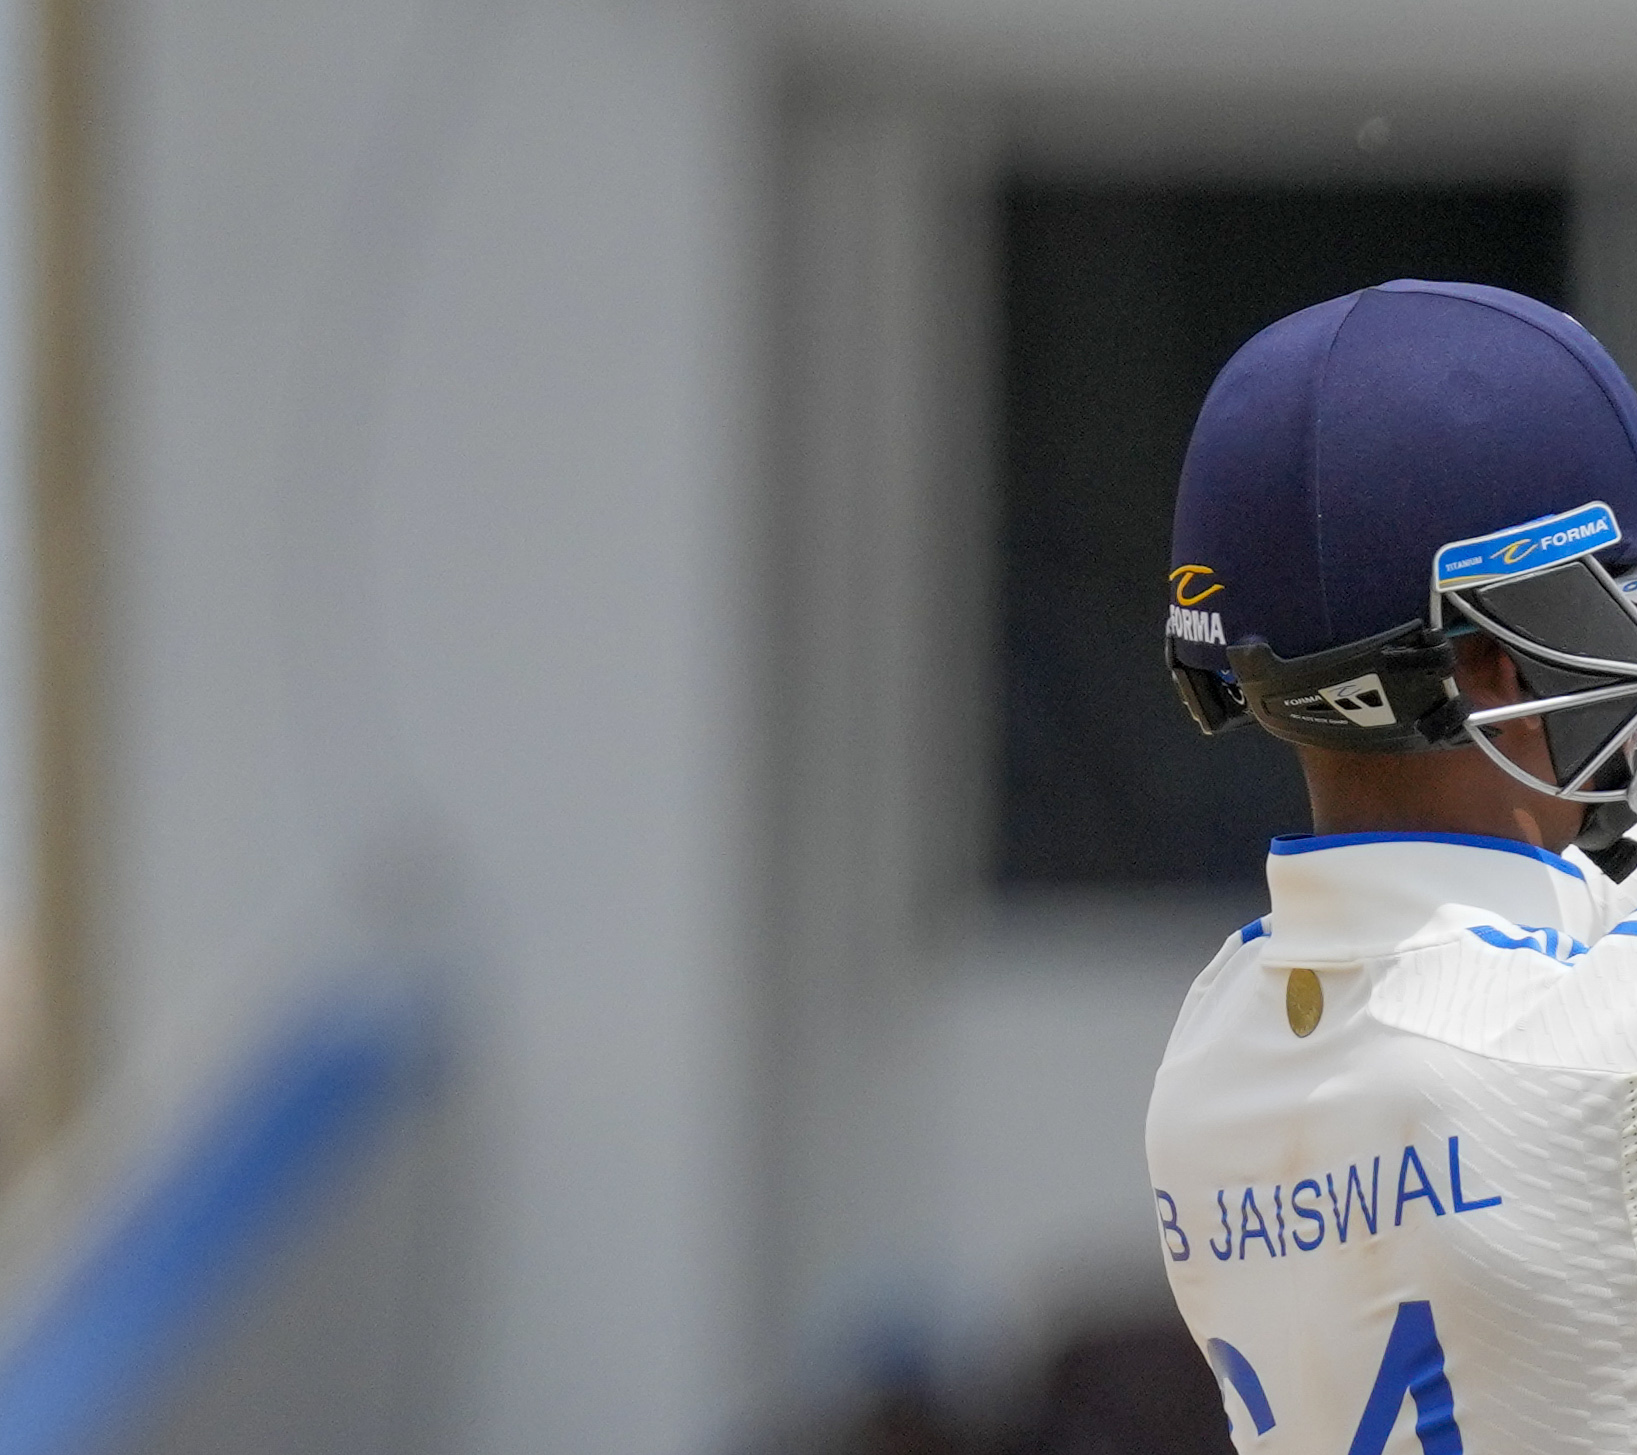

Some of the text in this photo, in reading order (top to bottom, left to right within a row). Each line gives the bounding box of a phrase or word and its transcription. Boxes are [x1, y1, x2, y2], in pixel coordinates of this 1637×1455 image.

[1445, 518, 1609, 572] TITANIUM FORMA
[1209, 1135, 1503, 1261] JAISWAL
